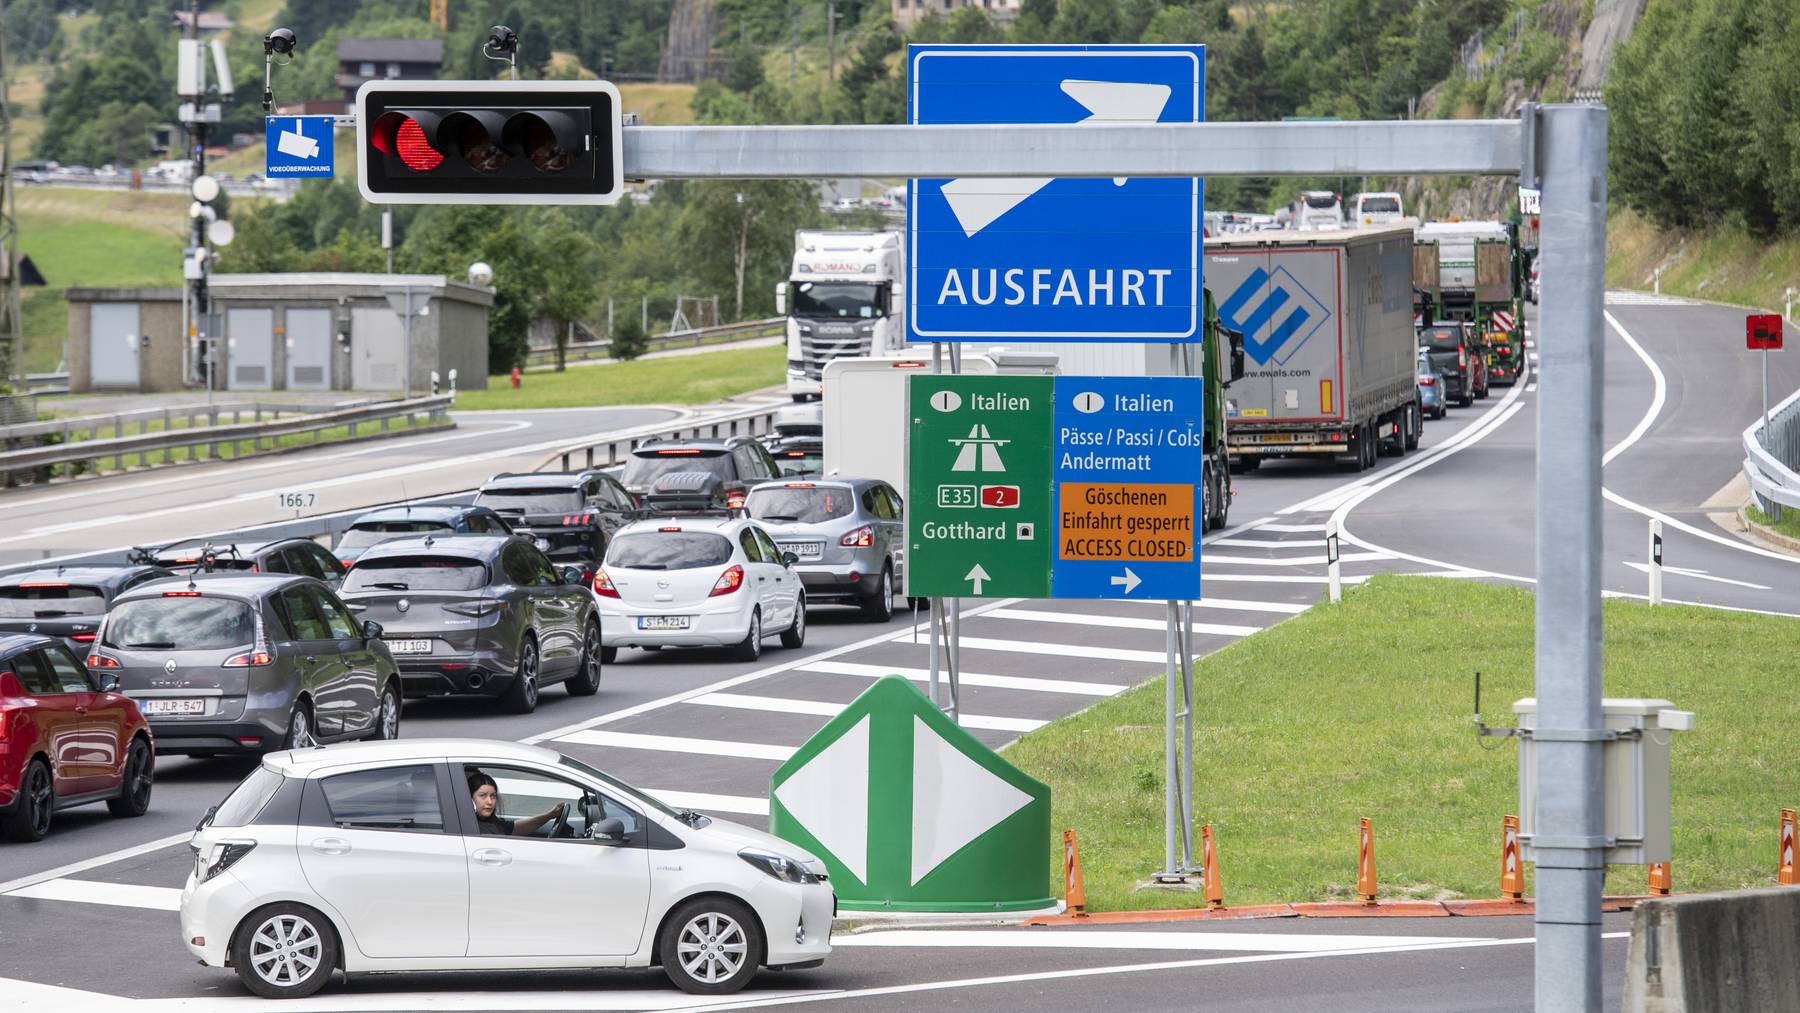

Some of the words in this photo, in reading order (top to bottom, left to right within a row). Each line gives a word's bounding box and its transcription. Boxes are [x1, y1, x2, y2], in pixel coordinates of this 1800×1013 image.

[814, 263, 862, 272] ROMANO
[937, 268, 1172, 306] AUSFAHRT
[1243, 369, 1311, 378] ww.ewals.com
[971, 392, 1030, 411] Italien
[1115, 394, 1174, 412] Italien
[1061, 427, 1103, 445] Pässe
[1116, 428, 1153, 446] Passi
[1167, 428, 1200, 447] Cols
[1060, 451, 1151, 471] Andermatt
[280, 493, 315, 507] 166.7
[996, 491, 1004, 504] 2
[1085, 487, 1167, 506] Göschenen
[922, 521, 1006, 540] Gotthard
[1063, 512, 1122, 530] Einfahrt
[1127, 514, 1190, 534] gesperrt
[1065, 538, 1122, 557] ACCESS
[1127, 540, 1186, 557] CLOSED
